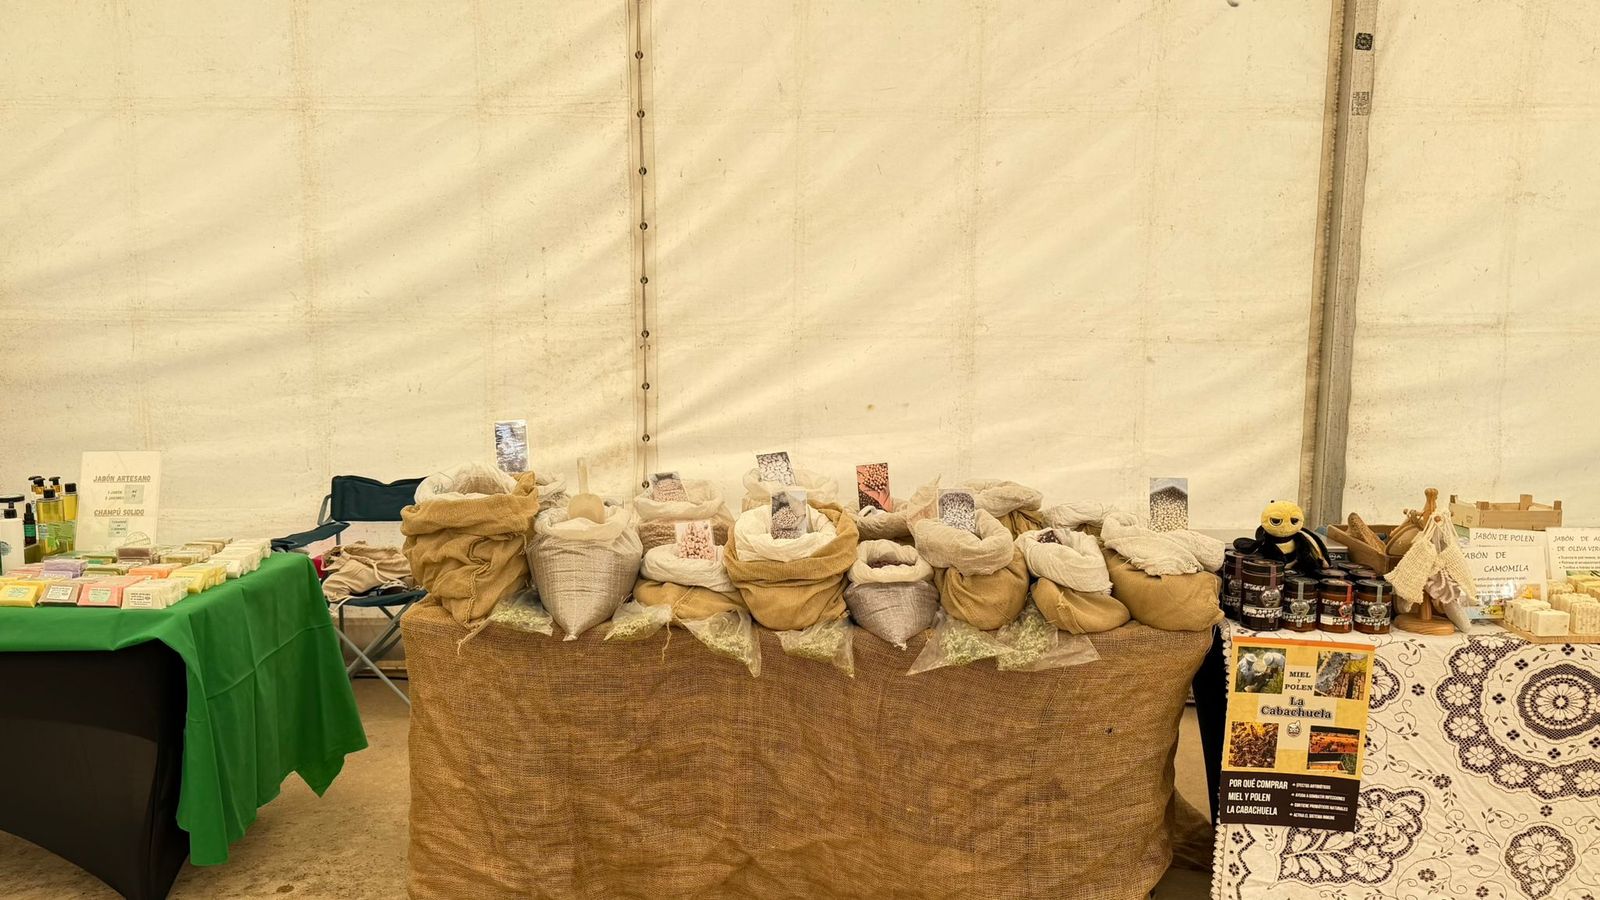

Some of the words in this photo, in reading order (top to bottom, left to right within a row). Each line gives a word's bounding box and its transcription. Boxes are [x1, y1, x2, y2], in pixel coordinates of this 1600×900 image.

[93, 474, 115, 482] JABÓN
[94, 508, 121, 516] CHAMPÚ
[1473, 532, 1497, 540] JABÓN
[1463, 551, 1488, 559] ABÓN
[1290, 697, 1304, 705] La
[1261, 706, 1332, 718] Cabachuela
[1229, 779, 1242, 787] POR
[1243, 778, 1256, 788] QUÉ
[1256, 780, 1288, 789] COMPRAR
[1228, 792, 1243, 800] MIEL
[1244, 792, 1249, 801] Y
[1250, 793, 1271, 802] POLEN
[1226, 805, 1234, 814] LA
[1236, 806, 1277, 815] CABACHUELA
